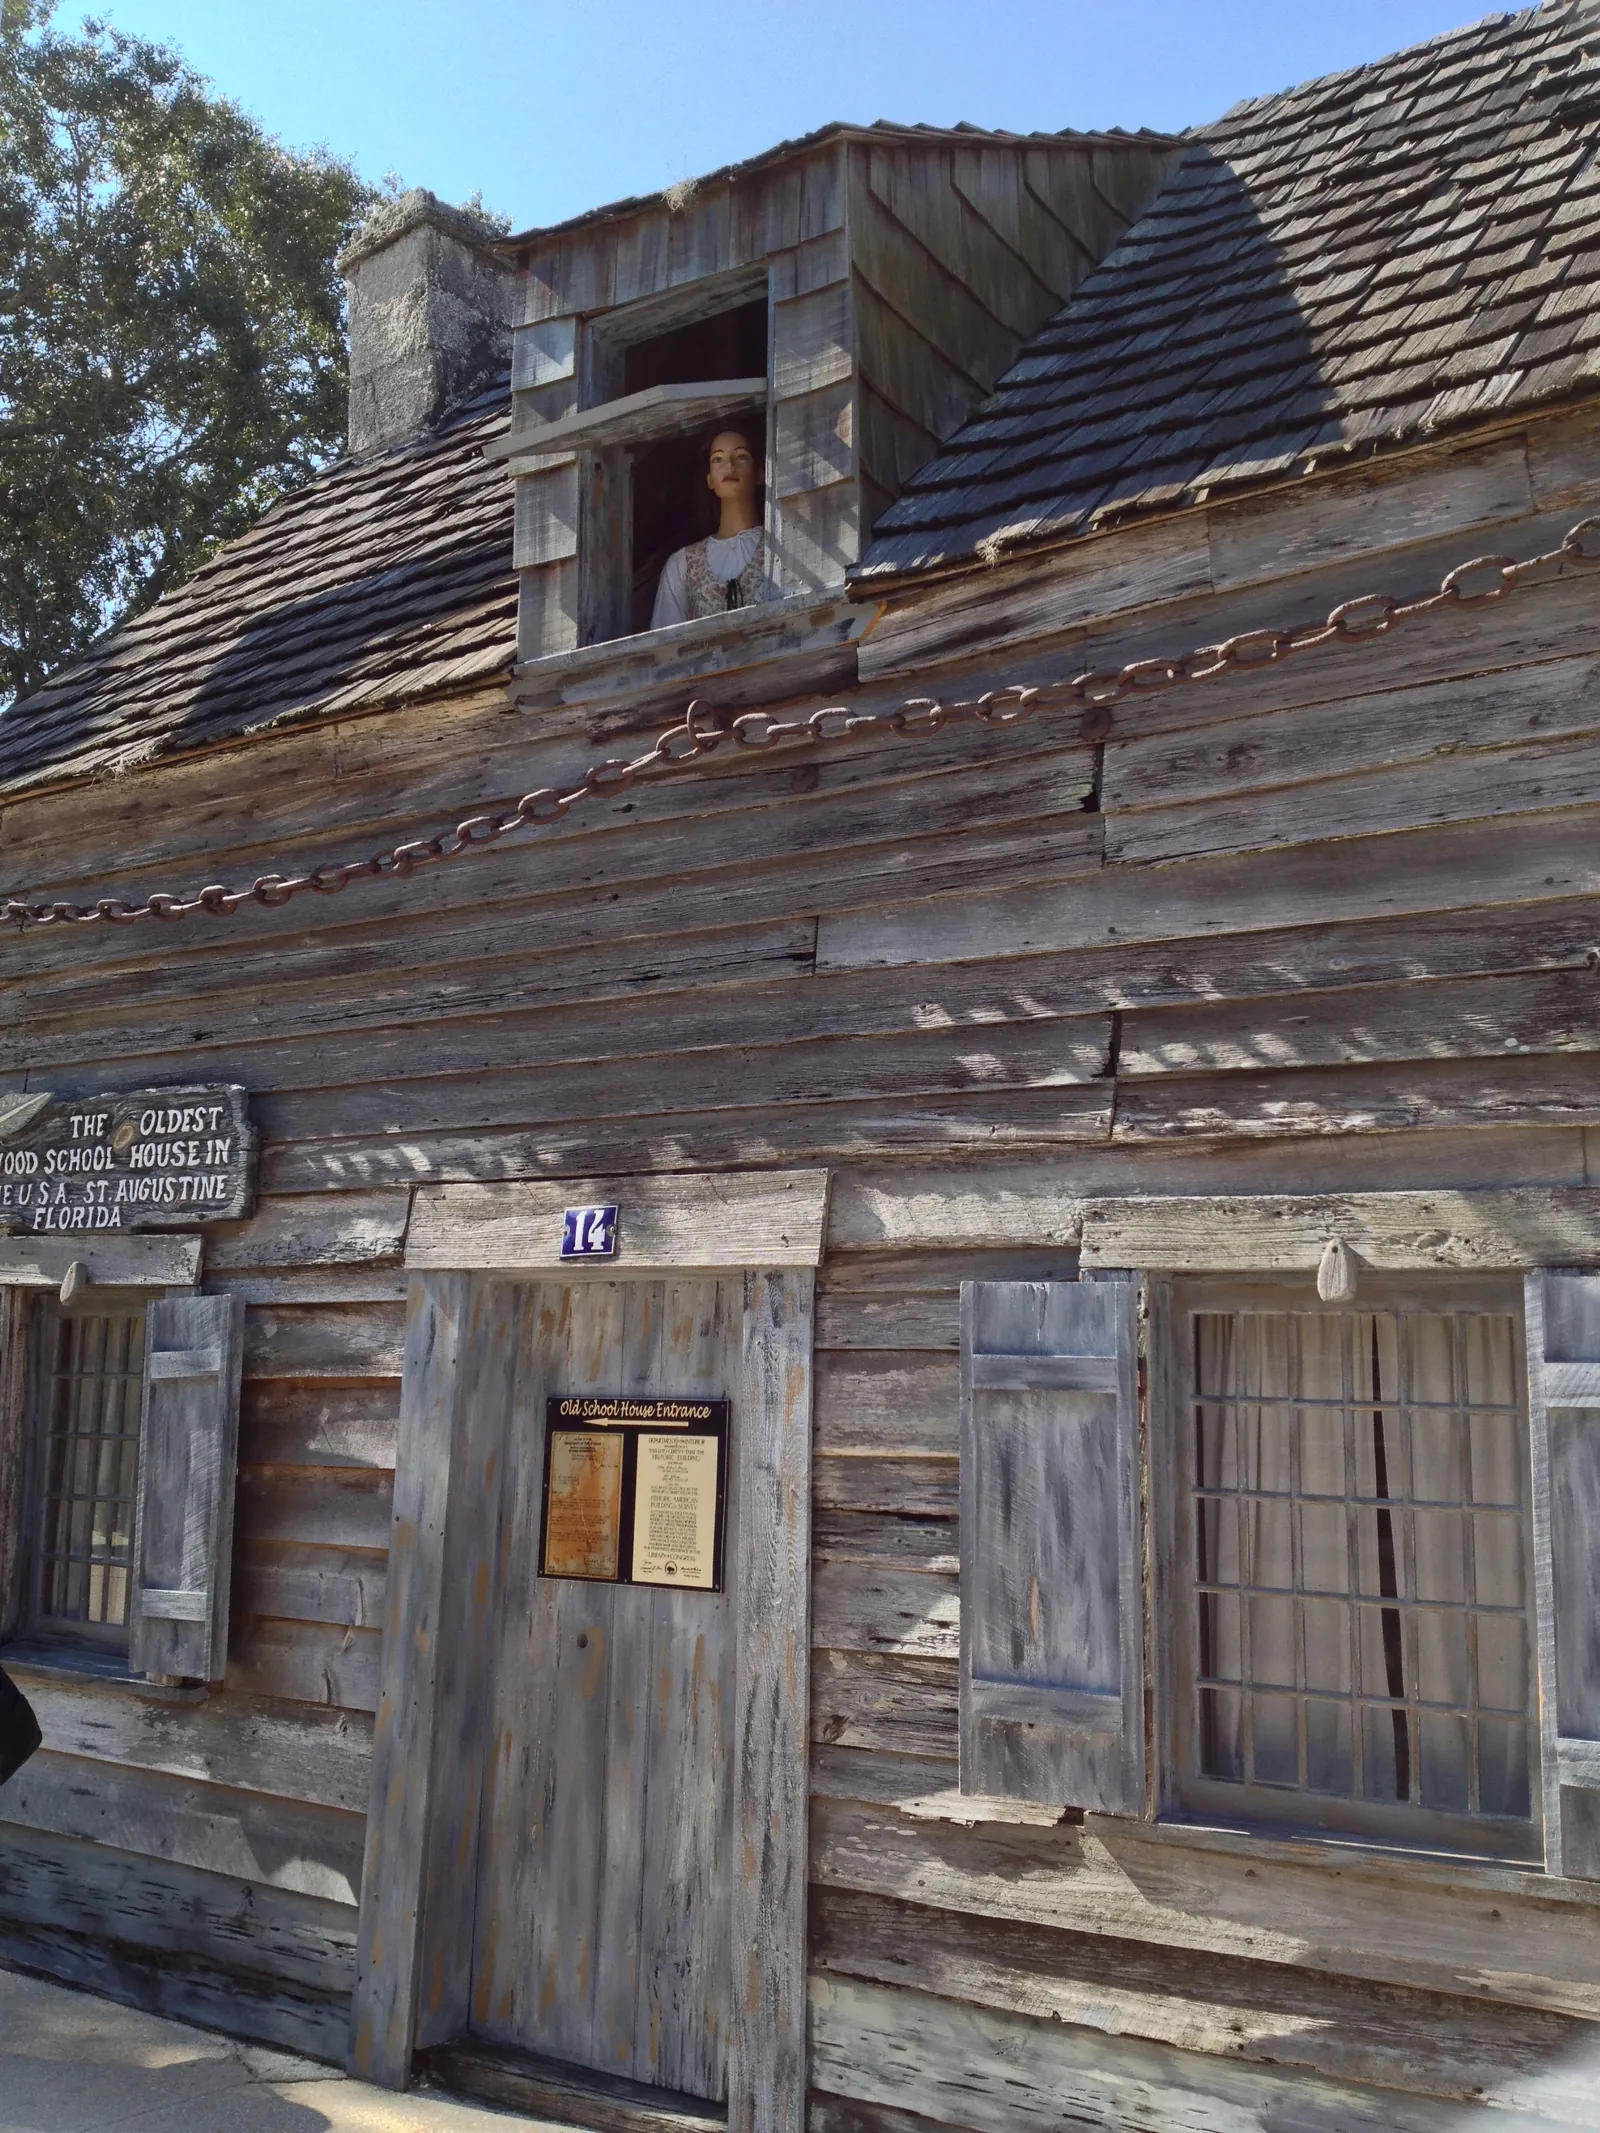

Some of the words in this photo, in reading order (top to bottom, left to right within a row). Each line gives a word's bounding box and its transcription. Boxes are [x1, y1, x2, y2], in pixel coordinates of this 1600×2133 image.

[70, 1113, 108, 1138] THE
[140, 1107, 223, 1136] OLDEST
[0, 1150, 38, 1175] OOD
[44, 1145, 115, 1174] SCHOOL
[129, 1141, 200, 1168] HOUSE
[205, 1137, 232, 1165] IN
[115, 1174, 228, 1203] AUGUSTINE
[33, 1206, 122, 1230] FLORIDA
[573, 1210, 606, 1251] 14
[560, 1399, 582, 1416] Old
[582, 1399, 620, 1417] School
[620, 1400, 656, 1418] House
[656, 1402, 712, 1419] Entrance
